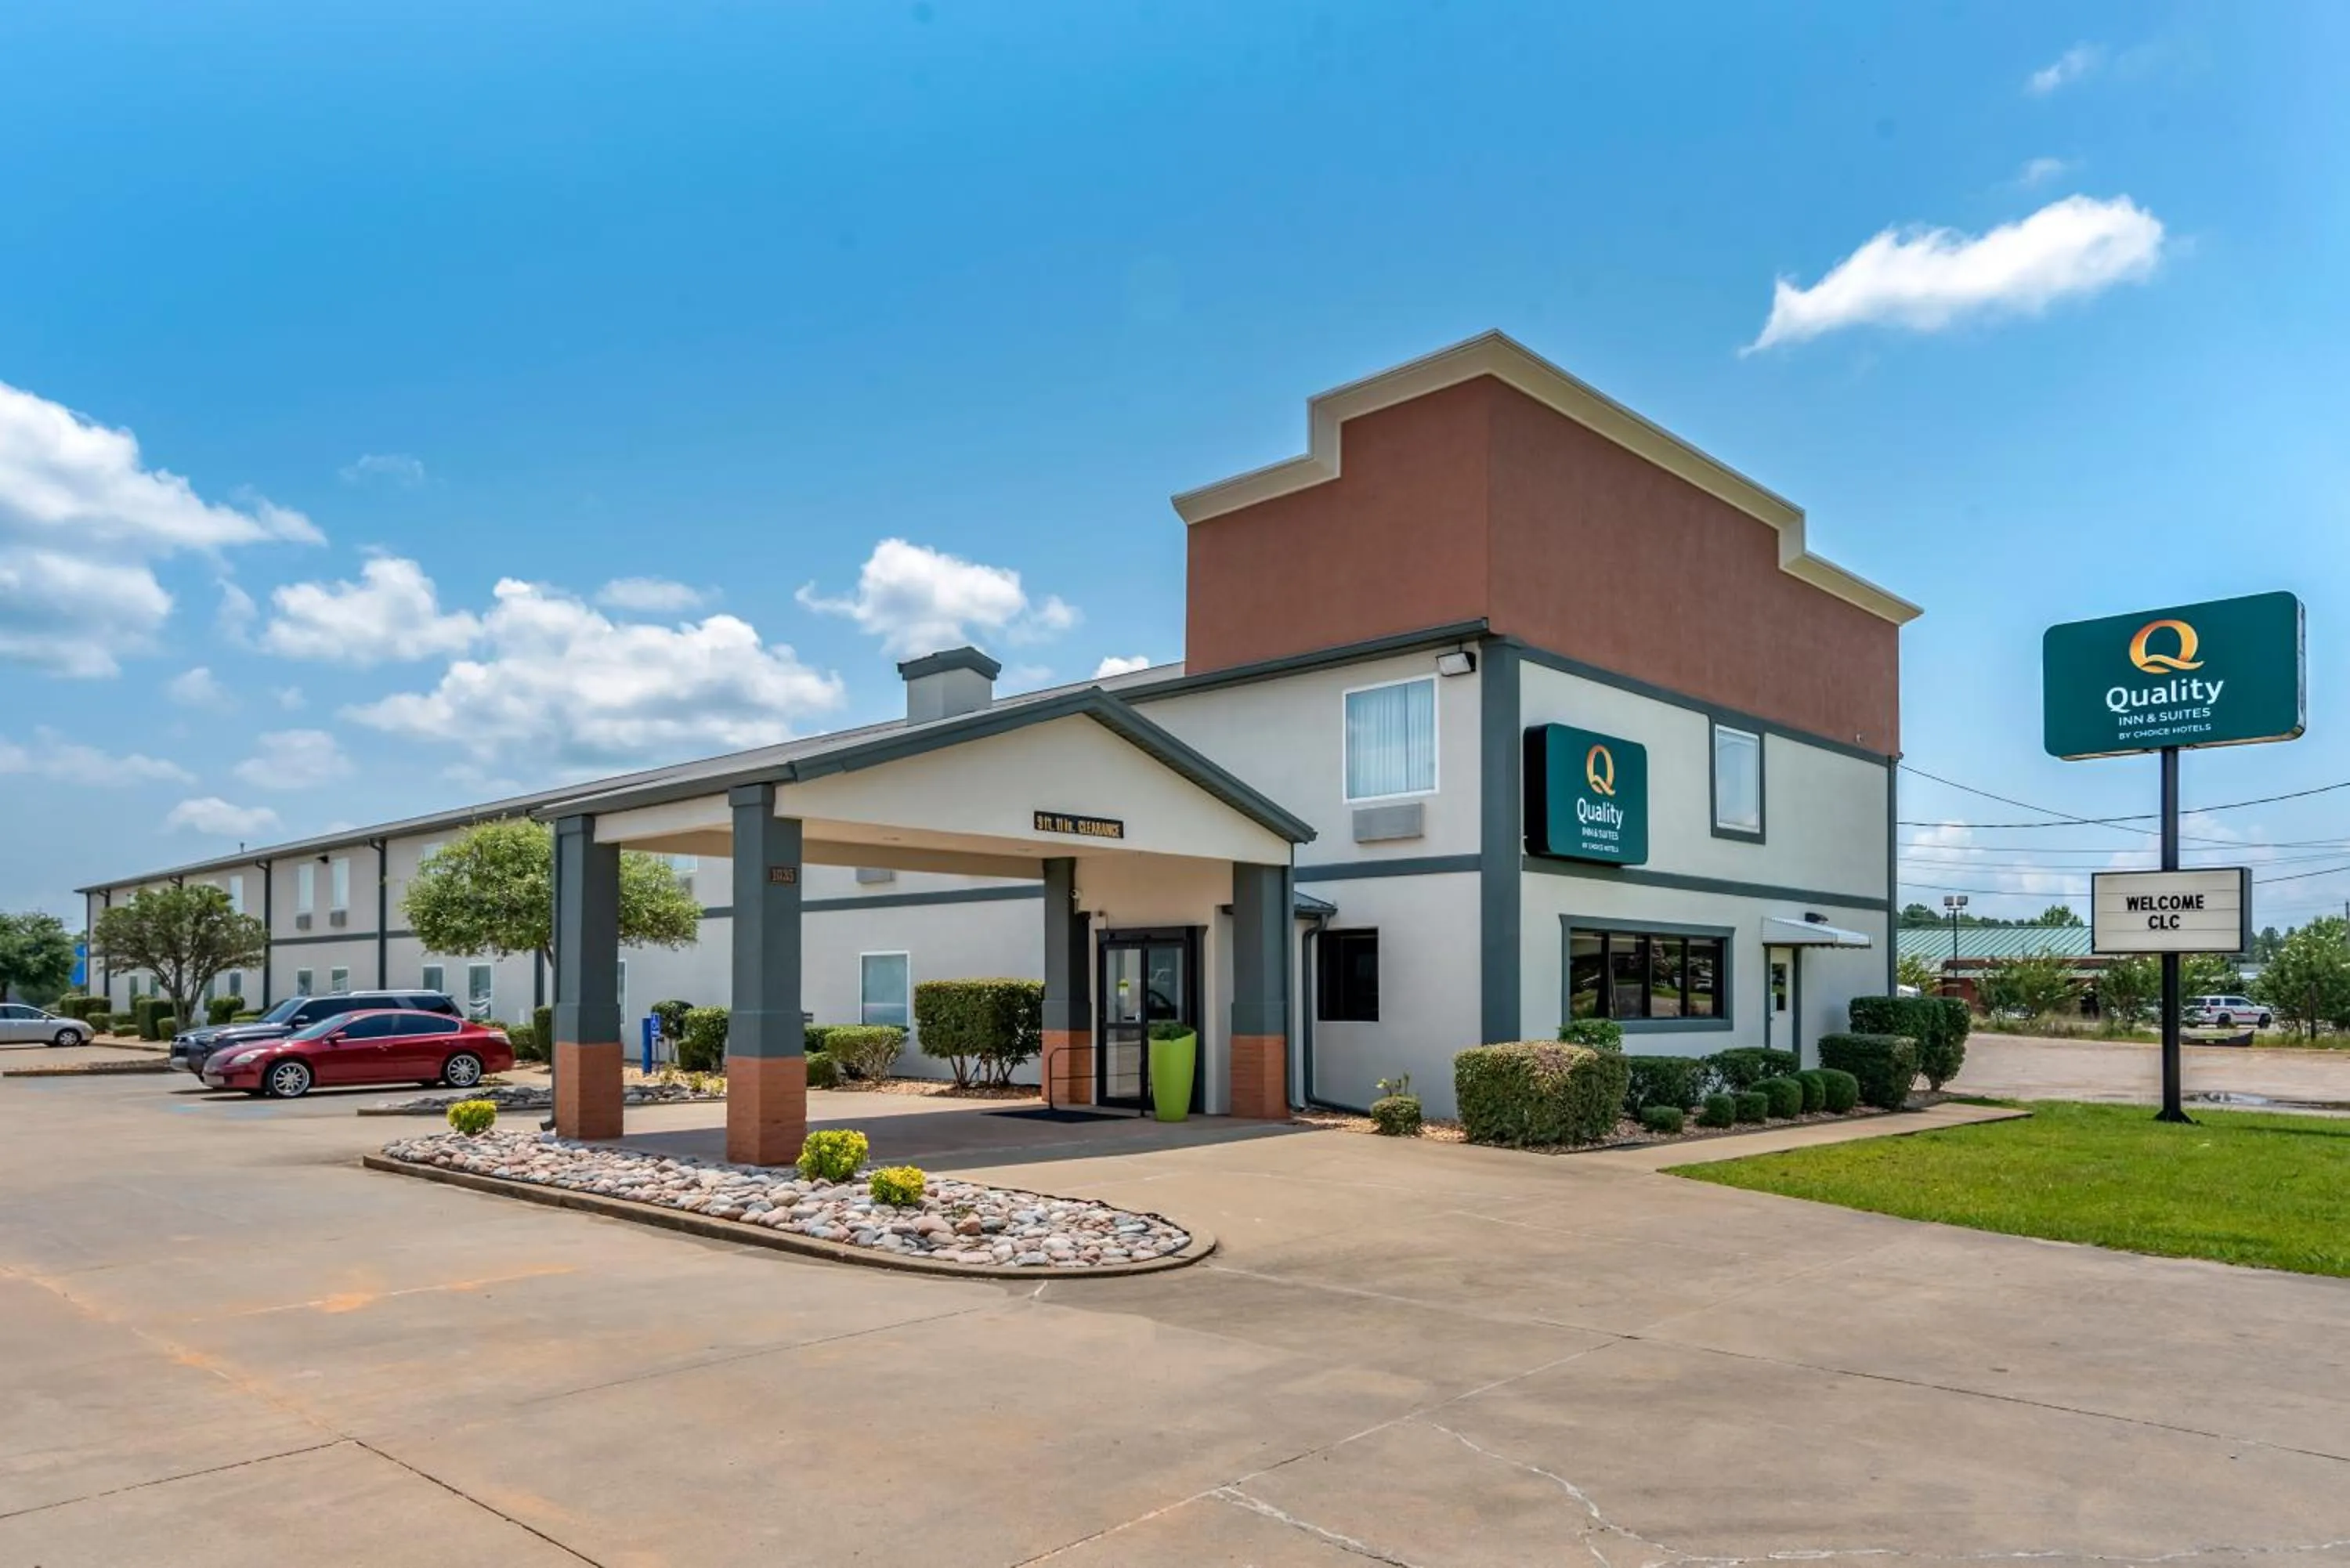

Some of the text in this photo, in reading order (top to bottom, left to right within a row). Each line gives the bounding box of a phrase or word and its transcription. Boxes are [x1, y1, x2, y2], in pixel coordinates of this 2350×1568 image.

[2106, 678, 2224, 714] Quality
[2118, 707, 2211, 727] INN & SUITES
[2118, 724, 2211, 740] BY CHOICE HOTELS
[1577, 797, 1623, 829] Quality
[2126, 894, 2204, 911] WELCOME
[2148, 914, 2180, 930] CLC
